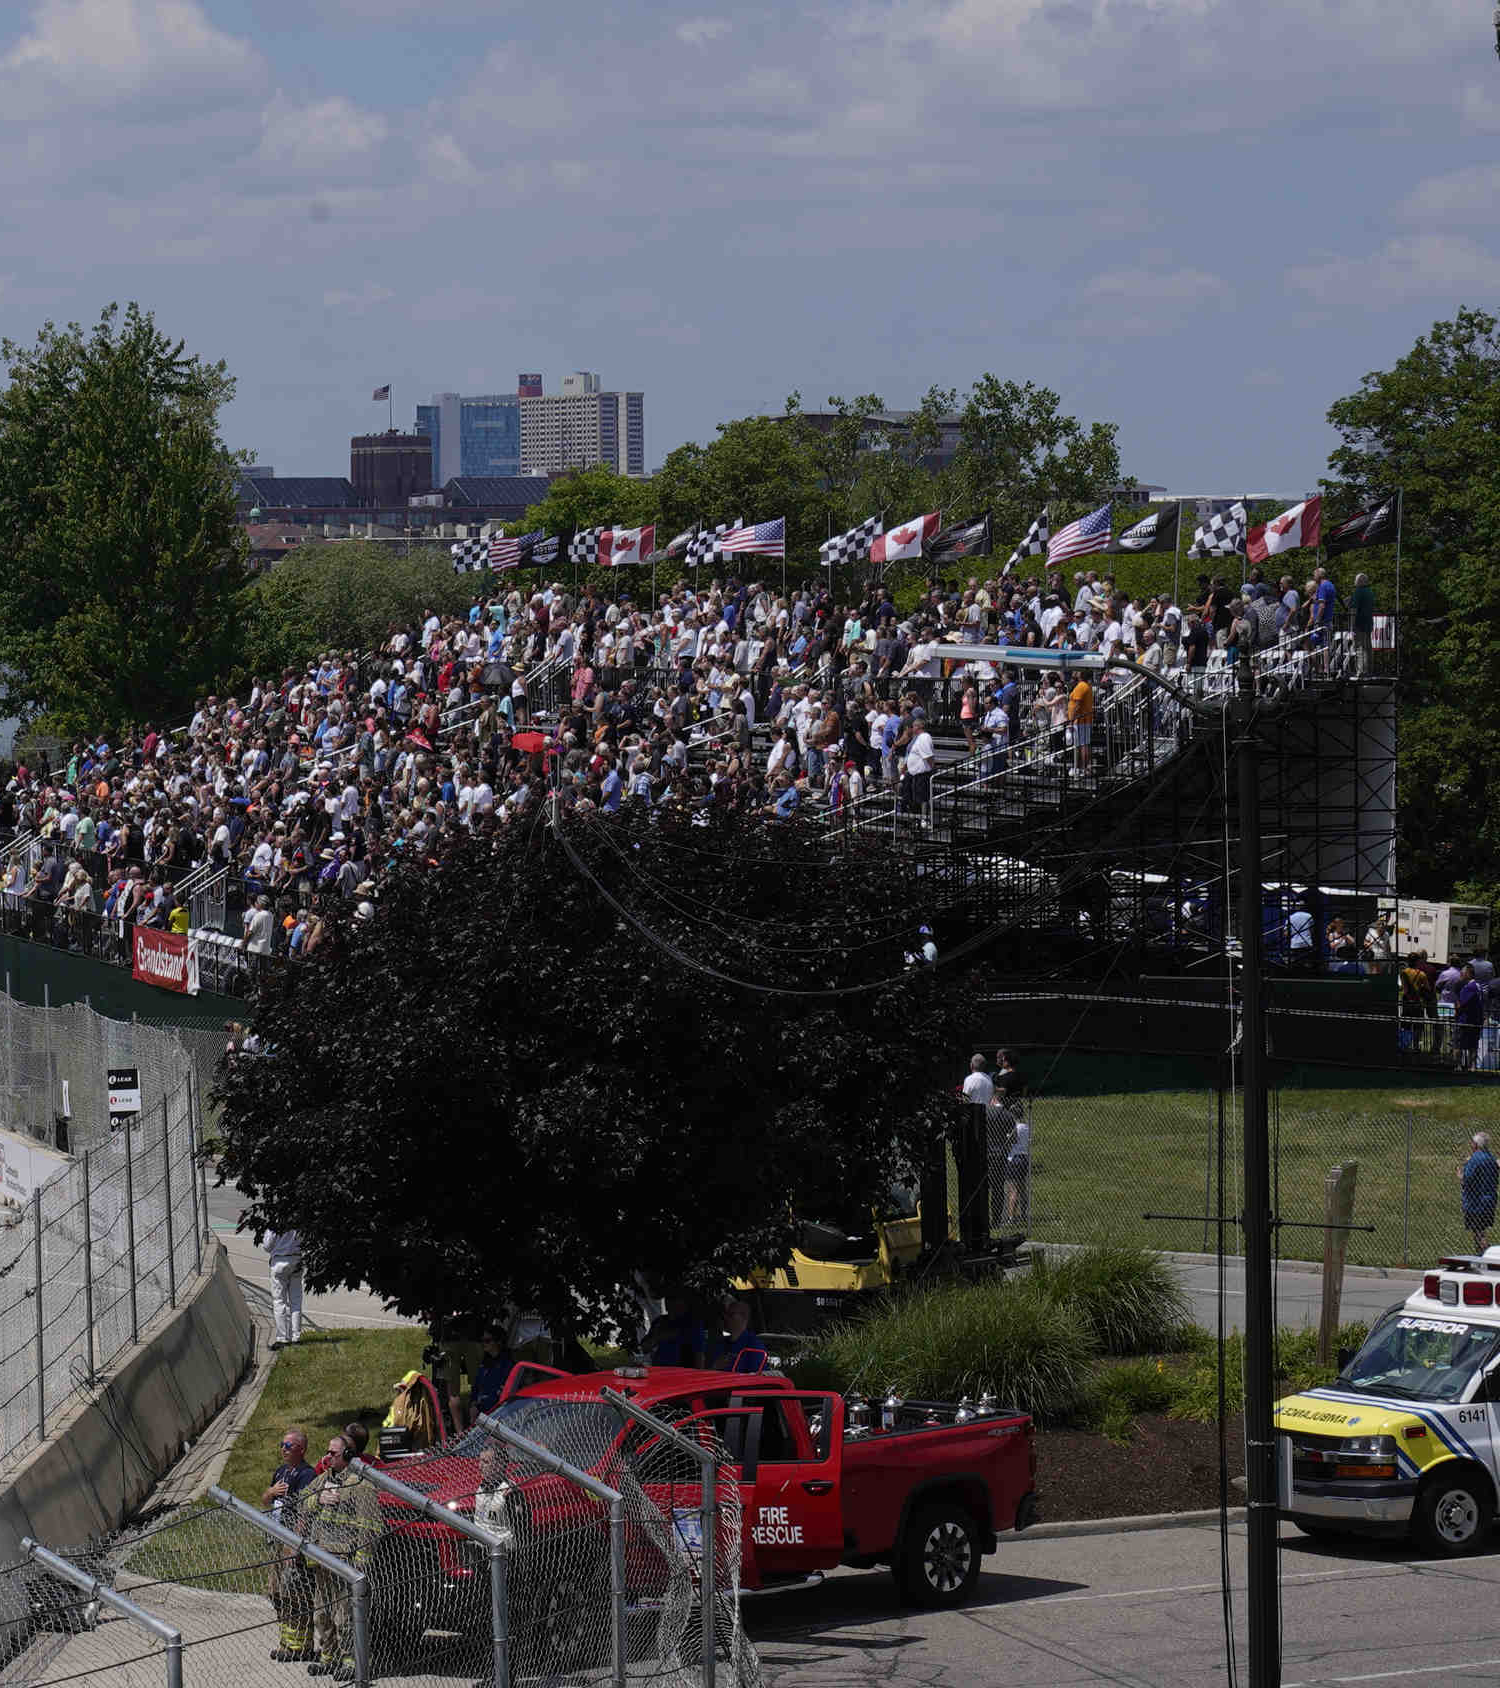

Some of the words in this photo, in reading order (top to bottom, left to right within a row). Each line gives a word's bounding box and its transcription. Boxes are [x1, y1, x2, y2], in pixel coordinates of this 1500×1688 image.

[137, 935, 185, 982] Grandstand
[1397, 1318, 1468, 1335] SUPERIOR
[1459, 1409, 1485, 1423] 6141
[758, 1507, 789, 1525] FIRE
